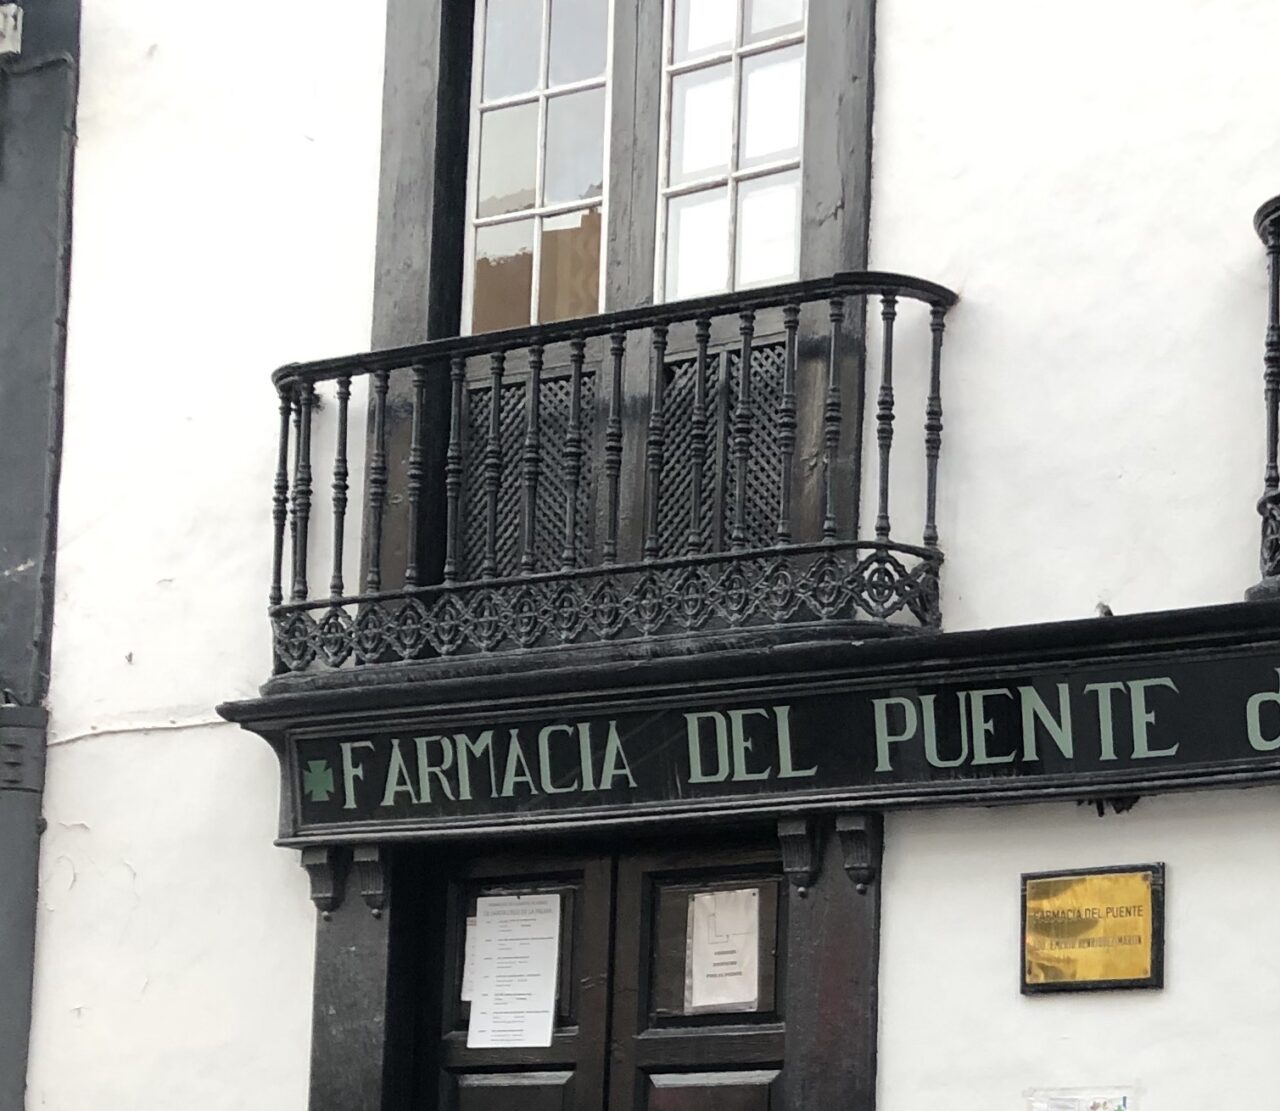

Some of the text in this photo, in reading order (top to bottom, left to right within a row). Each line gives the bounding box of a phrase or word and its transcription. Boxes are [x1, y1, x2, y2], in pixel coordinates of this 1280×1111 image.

[340, 720, 638, 809] FARMACIA
[684, 705, 818, 784] DEL
[871, 677, 1180, 772] PUENTE
[1084, 907, 1102, 919] DEL
[1105, 905, 1143, 918] PUENTE
